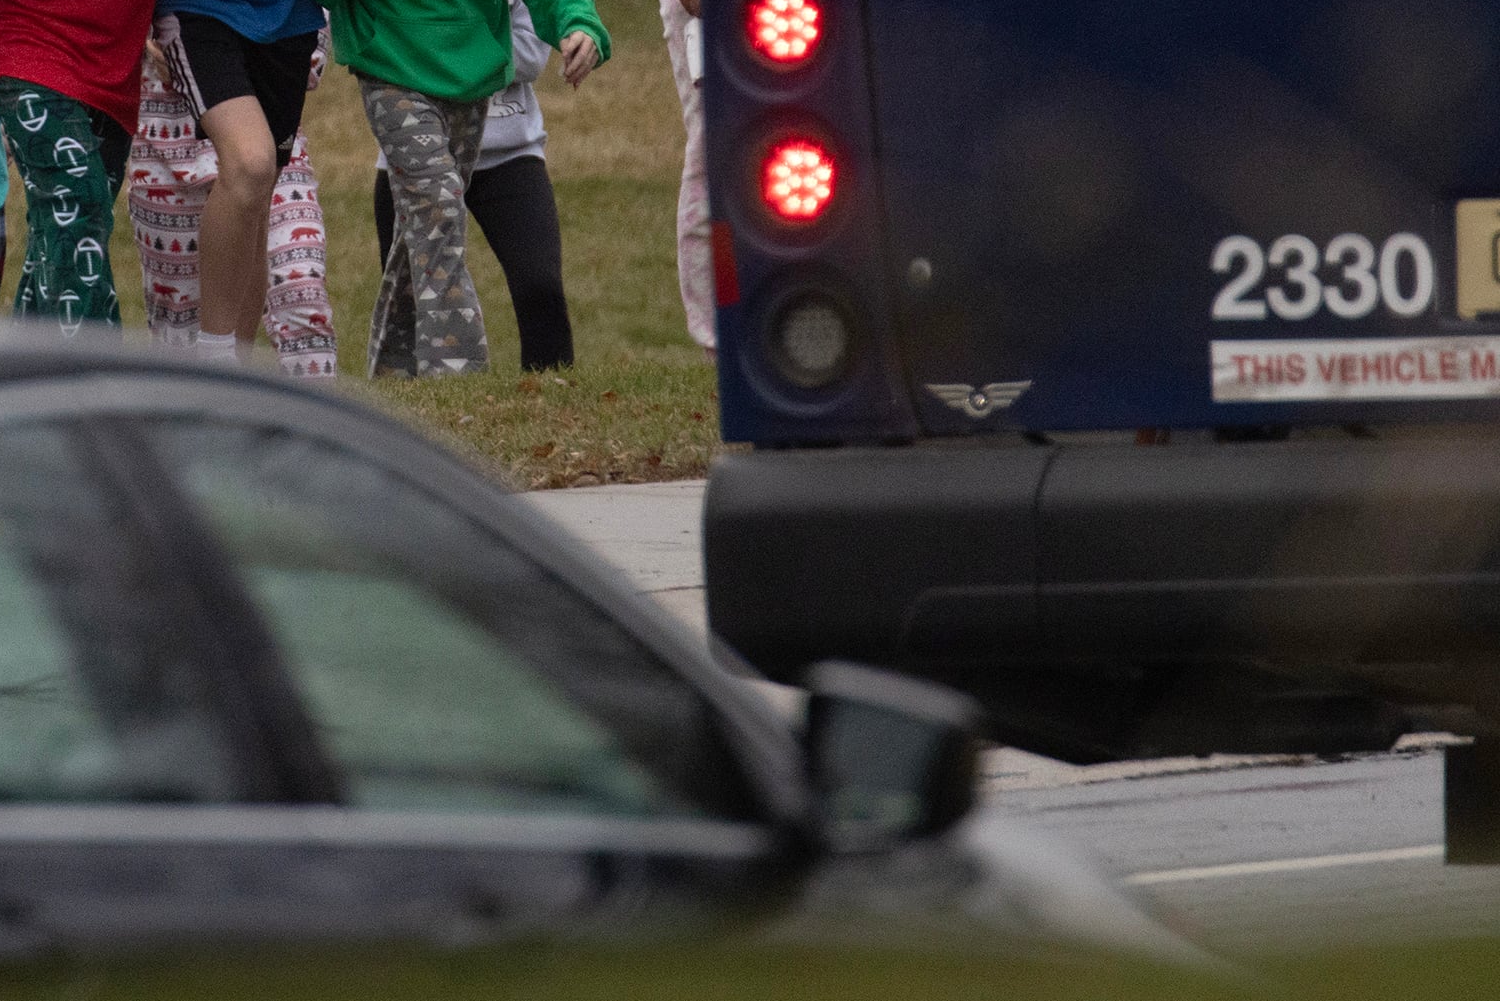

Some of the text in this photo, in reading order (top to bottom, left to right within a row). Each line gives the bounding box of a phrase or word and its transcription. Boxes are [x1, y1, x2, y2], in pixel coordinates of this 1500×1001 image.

[1211, 232, 1434, 320] 2330
[1231, 350, 1500, 385] THIS VEHICLE M
